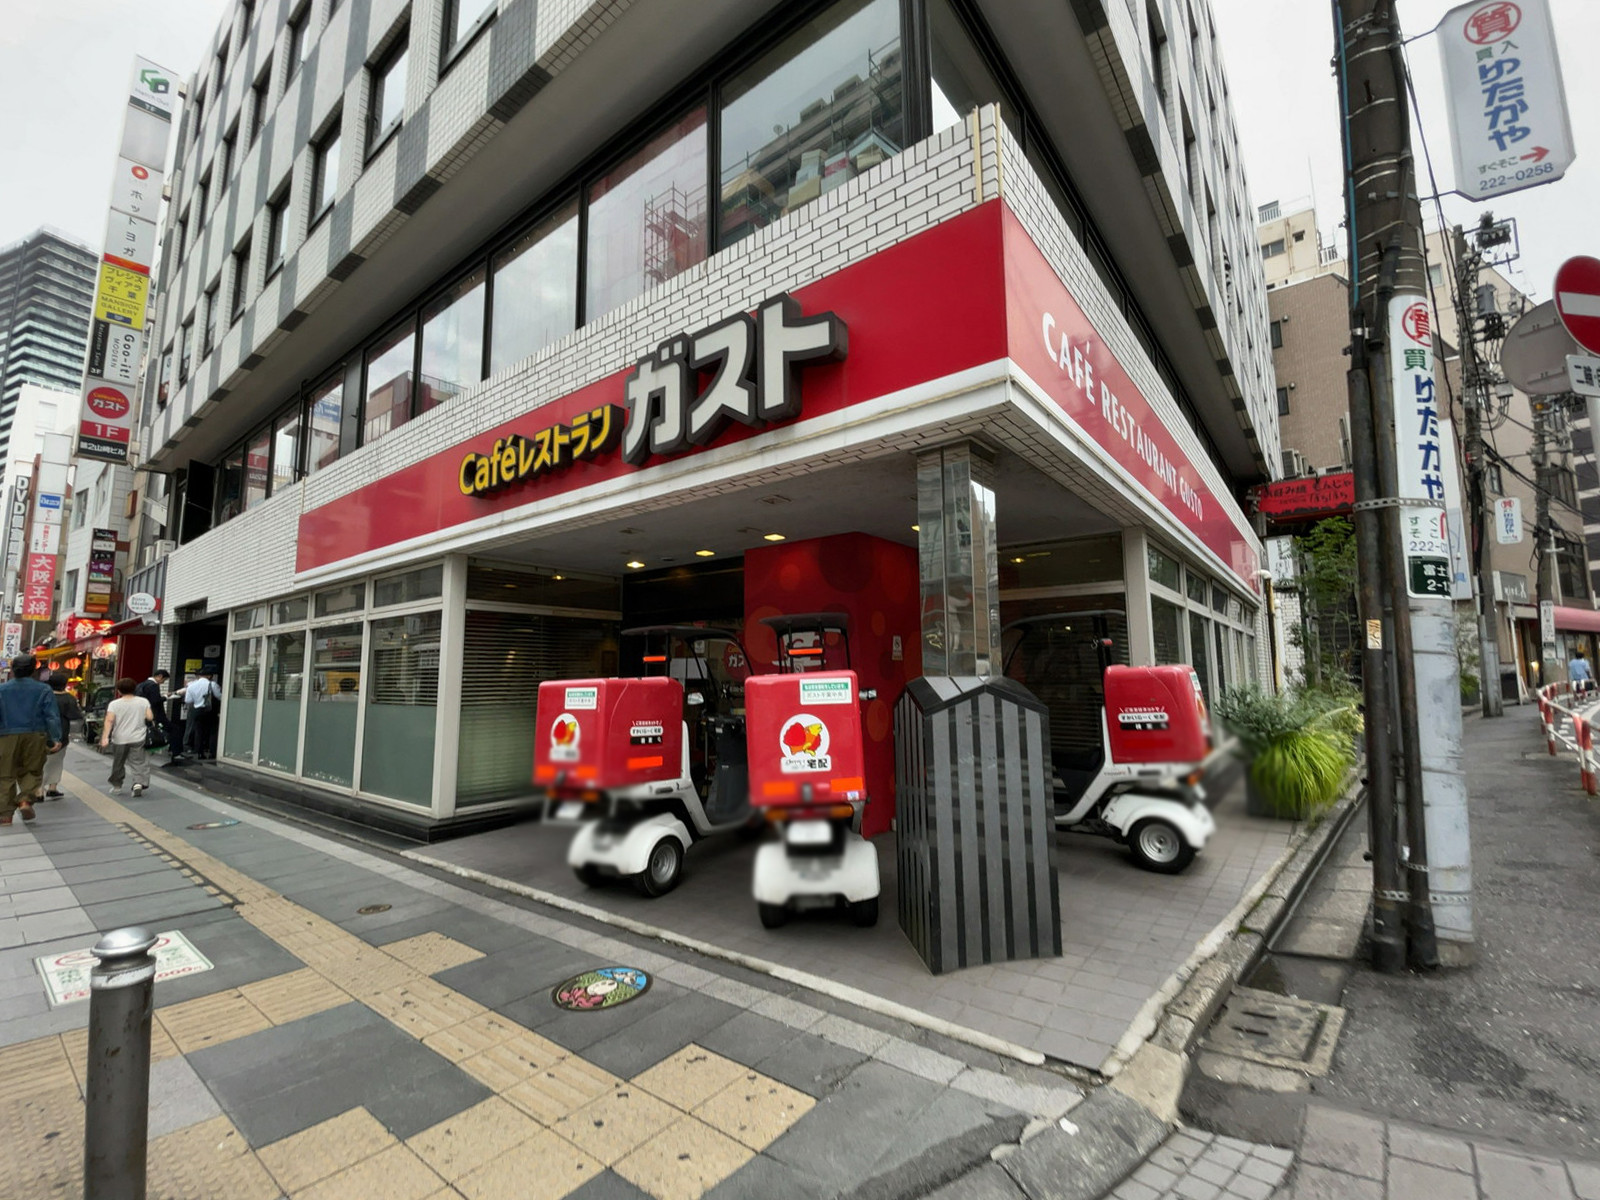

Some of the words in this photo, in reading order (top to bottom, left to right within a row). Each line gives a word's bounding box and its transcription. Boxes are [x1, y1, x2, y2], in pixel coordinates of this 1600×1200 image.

[1478, 57, 1531, 152] ゆたかや
[1478, 156, 1519, 175] すぐそこ
[1479, 162, 1554, 191] 222-0258
[123, 189, 144, 258] ホットヨガ
[110, 337, 121, 368] MODERN
[119, 334, 135, 379] Goo-it!
[1404, 348, 1434, 372] 買
[623, 298, 834, 459] ガスト
[93, 398, 126, 411] ガスト
[1042, 312, 1096, 405] CAFÉ
[1100, 380, 1177, 495] RESTAURANT
[1179, 476, 1203, 522] GUSTO
[95, 424, 120, 437] 1F
[13, 476, 29, 515] DVD
[28, 555, 53, 615] 大阪王将
[1423, 563, 1449, 577] 富士
[807, 758, 828, 768] 宅配
